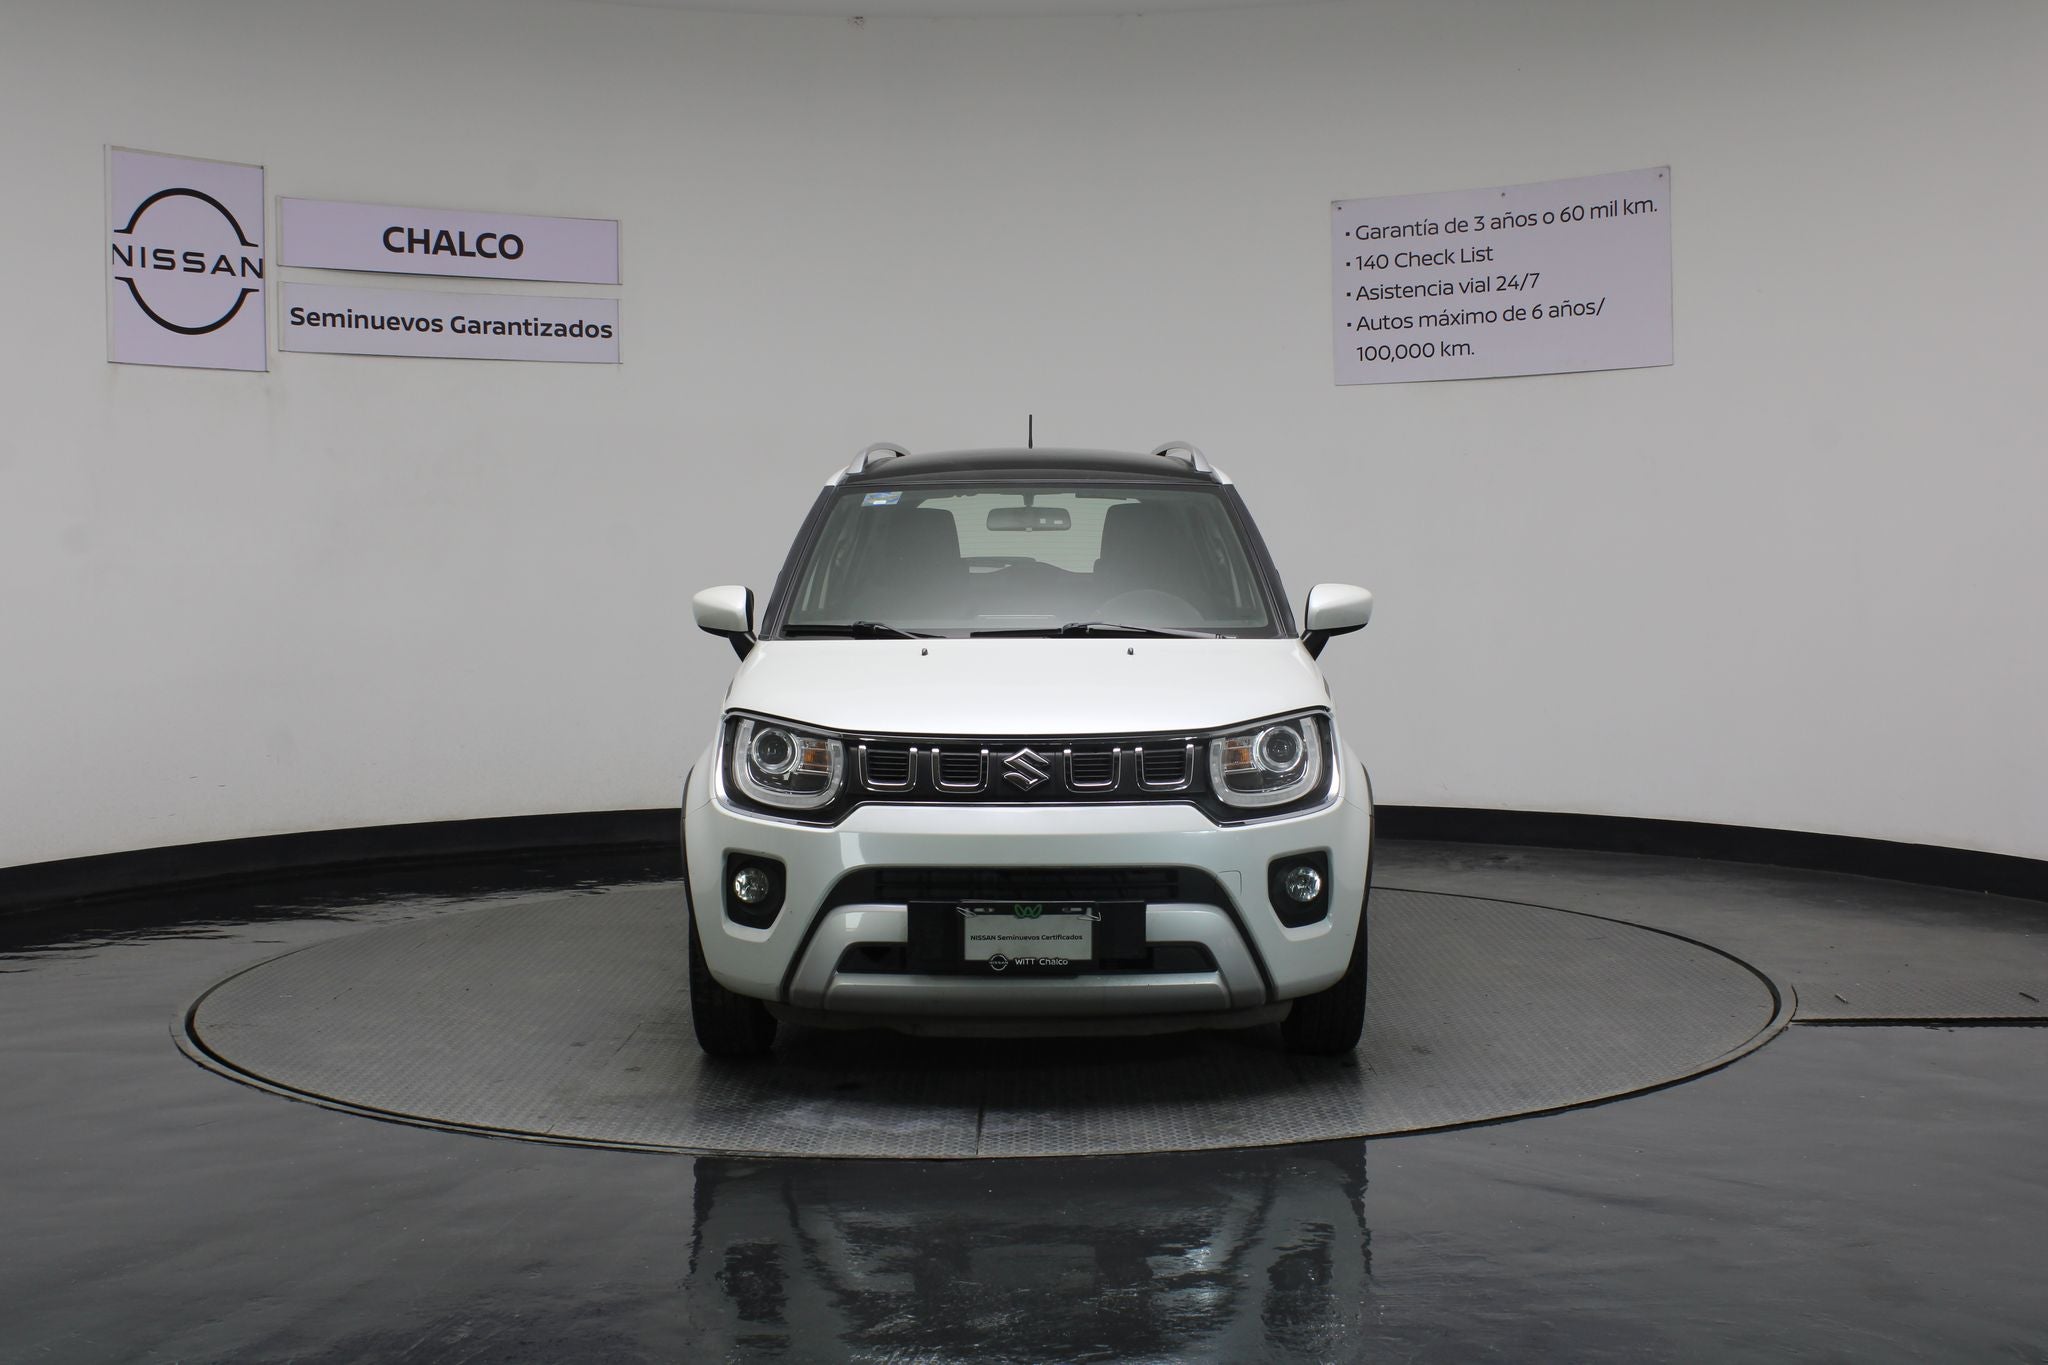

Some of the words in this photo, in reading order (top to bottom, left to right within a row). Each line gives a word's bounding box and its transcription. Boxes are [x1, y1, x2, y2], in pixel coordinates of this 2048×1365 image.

[1356, 216, 1439, 240] Garantía
[1445, 216, 1469, 235] de
[1474, 215, 1486, 231] 3
[1490, 211, 1538, 230] años
[1543, 211, 1556, 225] o
[1560, 205, 1585, 222] 60
[1590, 199, 1618, 219] mil
[1624, 198, 1658, 215] km.
[383, 226, 523, 261] CHALCO
[1356, 253, 1390, 270] 140
[1393, 248, 1456, 268] Check
[1461, 245, 1495, 263] List
[111, 242, 265, 280] NISSAN
[1356, 280, 1454, 301] Asistencia
[1459, 276, 1491, 294] vial
[1496, 273, 1541, 291] 24/7
[291, 306, 444, 333] Seminuevos
[450, 315, 613, 339] Garantizados
[1356, 314, 1414, 331] Autos
[1418, 308, 1498, 329] máximo
[1503, 305, 1527, 322] de
[1532, 304, 1544, 320] 6
[1549, 296, 1606, 319] años/
[1357, 342, 1436, 363] 100,000
[1441, 341, 1476, 358] km.
[1014, 958, 1036, 966] WITT
[1039, 958, 1069, 966] Chalco
